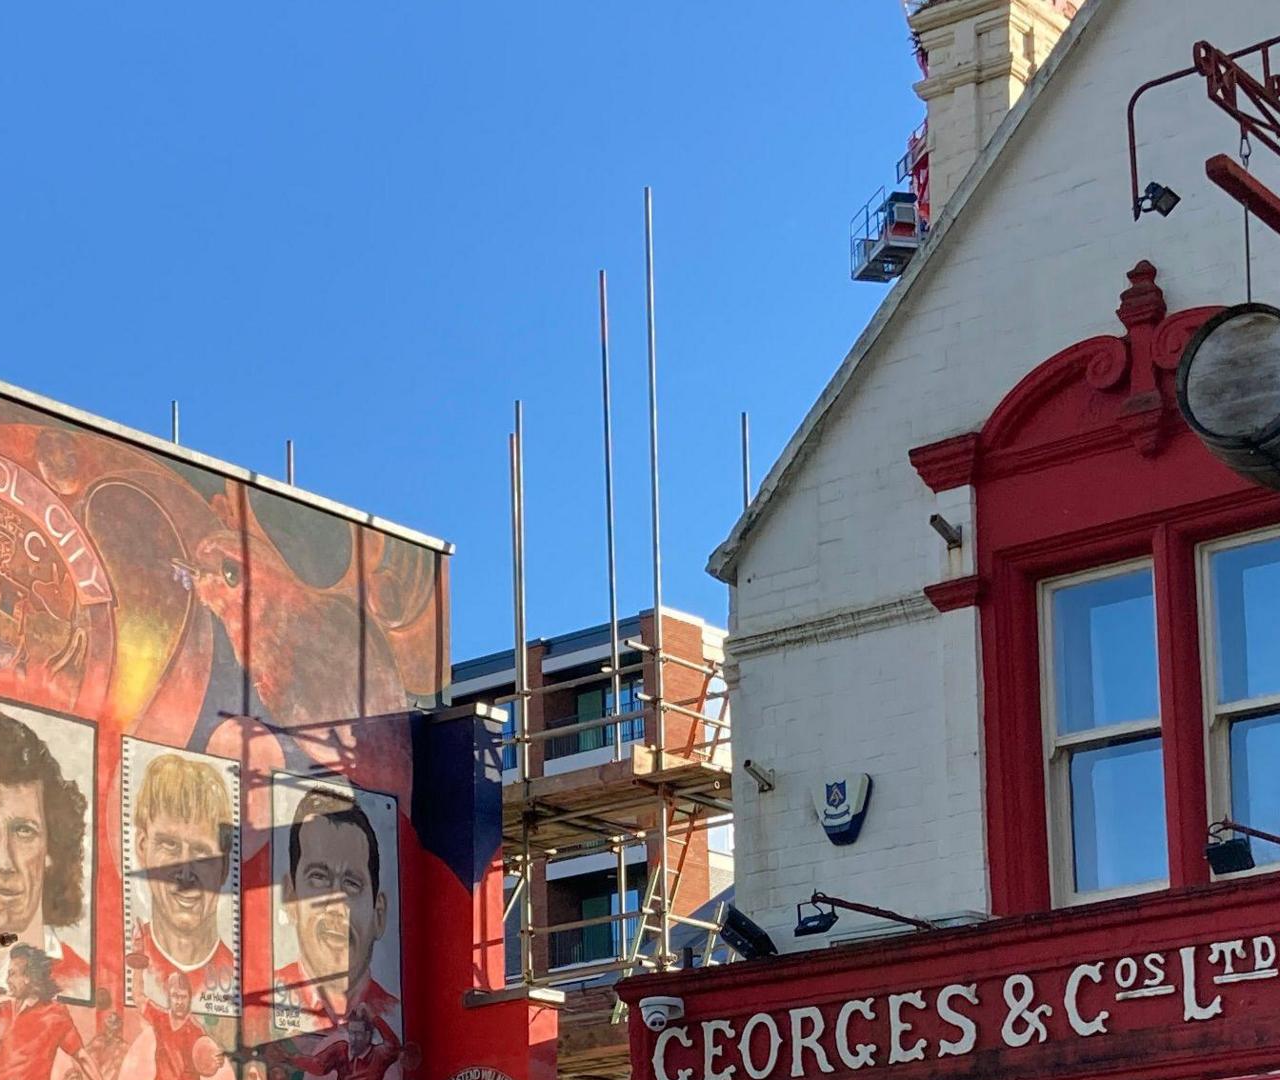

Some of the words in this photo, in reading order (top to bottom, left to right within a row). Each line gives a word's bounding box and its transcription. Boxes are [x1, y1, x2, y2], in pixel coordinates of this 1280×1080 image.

[23, 530, 48, 562] C
[45, 503, 105, 593] CITY
[1001, 973, 1053, 1048] &
